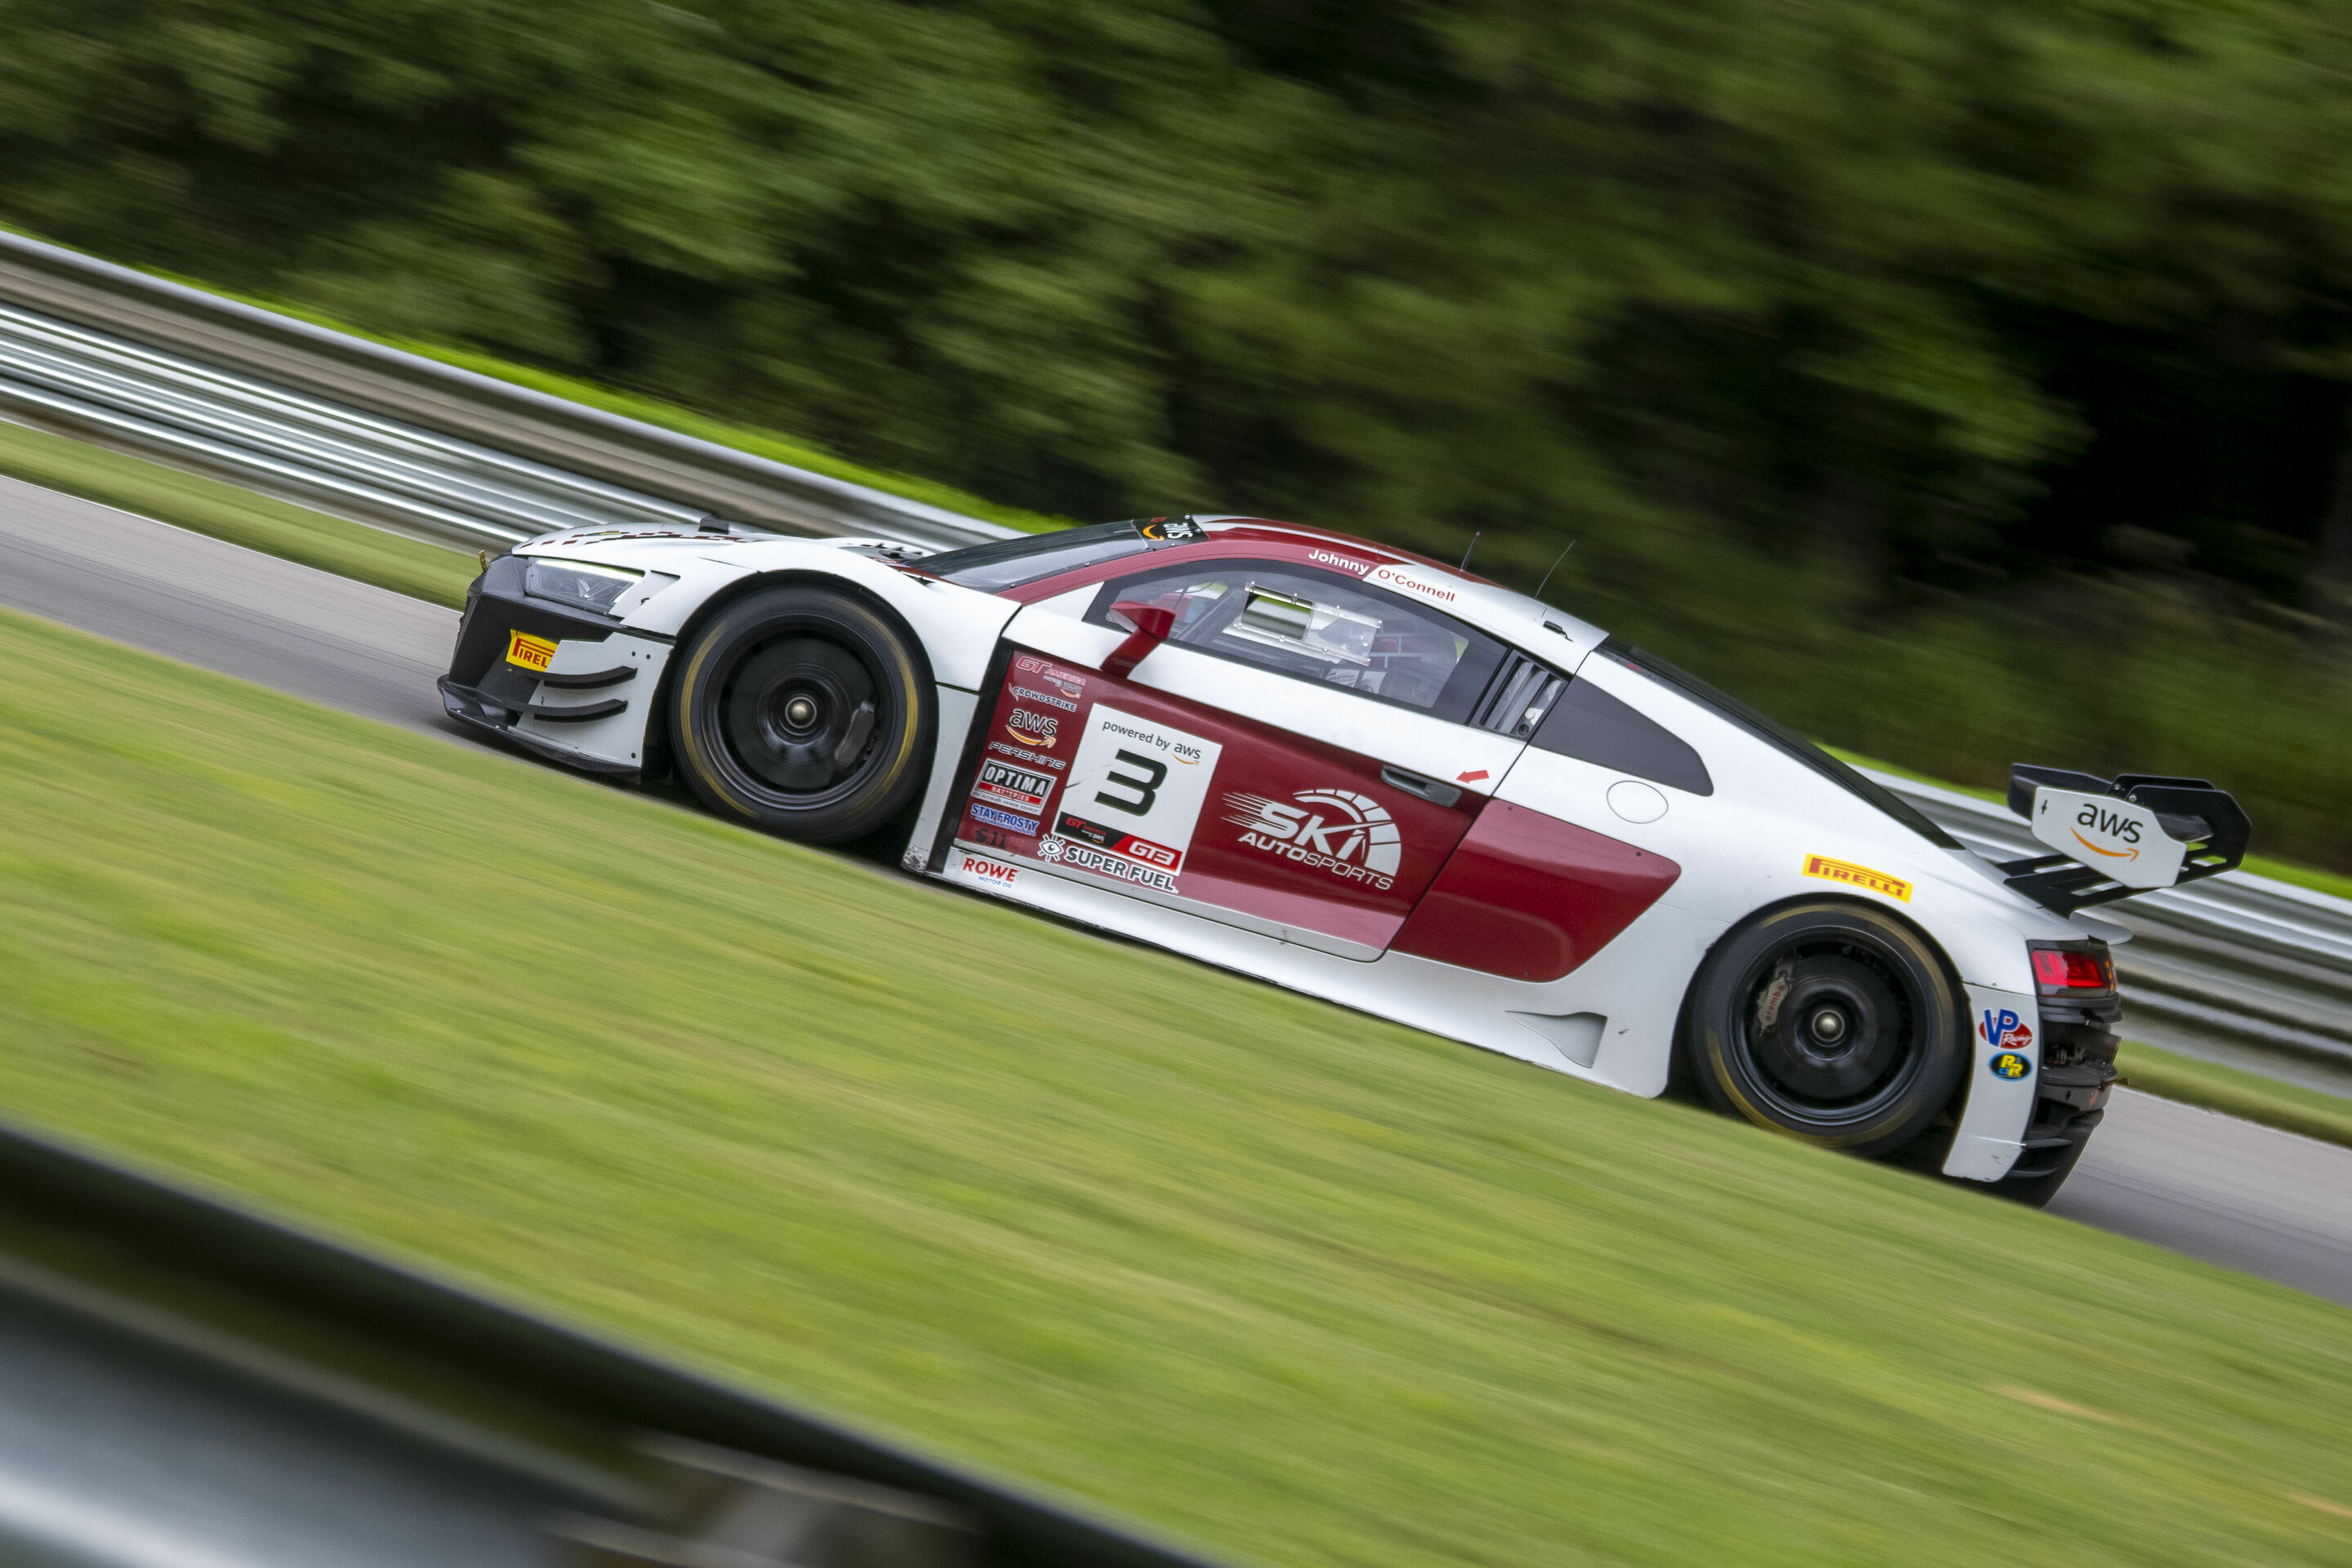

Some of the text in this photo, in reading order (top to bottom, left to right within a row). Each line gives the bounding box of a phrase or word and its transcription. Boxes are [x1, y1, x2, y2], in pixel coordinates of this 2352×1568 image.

[1308, 550, 1455, 602] Johnny O'Connell
[513, 638, 555, 668] PIREL
[1016, 657, 1053, 674] GT
[1013, 687, 1077, 712] CROWDSTRIKE
[1010, 709, 1058, 737] aws
[1102, 721, 1201, 760] powered by aws
[984, 766, 1047, 795] OPTIMA
[1094, 749, 1168, 817] 3
[971, 804, 995, 820] STAY
[996, 810, 1039, 832] FROSTY
[1066, 817, 1086, 828] GT
[2077, 803, 2144, 844] aws
[1129, 841, 1176, 866] GT3
[1238, 832, 1394, 890] AUTOSPORTS
[962, 858, 1020, 882] ROWE
[979, 876, 1001, 886] MOTOR
[1065, 846, 1174, 891] SUPER FUEL
[1809, 858, 1906, 897] PIRELLI
[1983, 1009, 2020, 1047] VP
